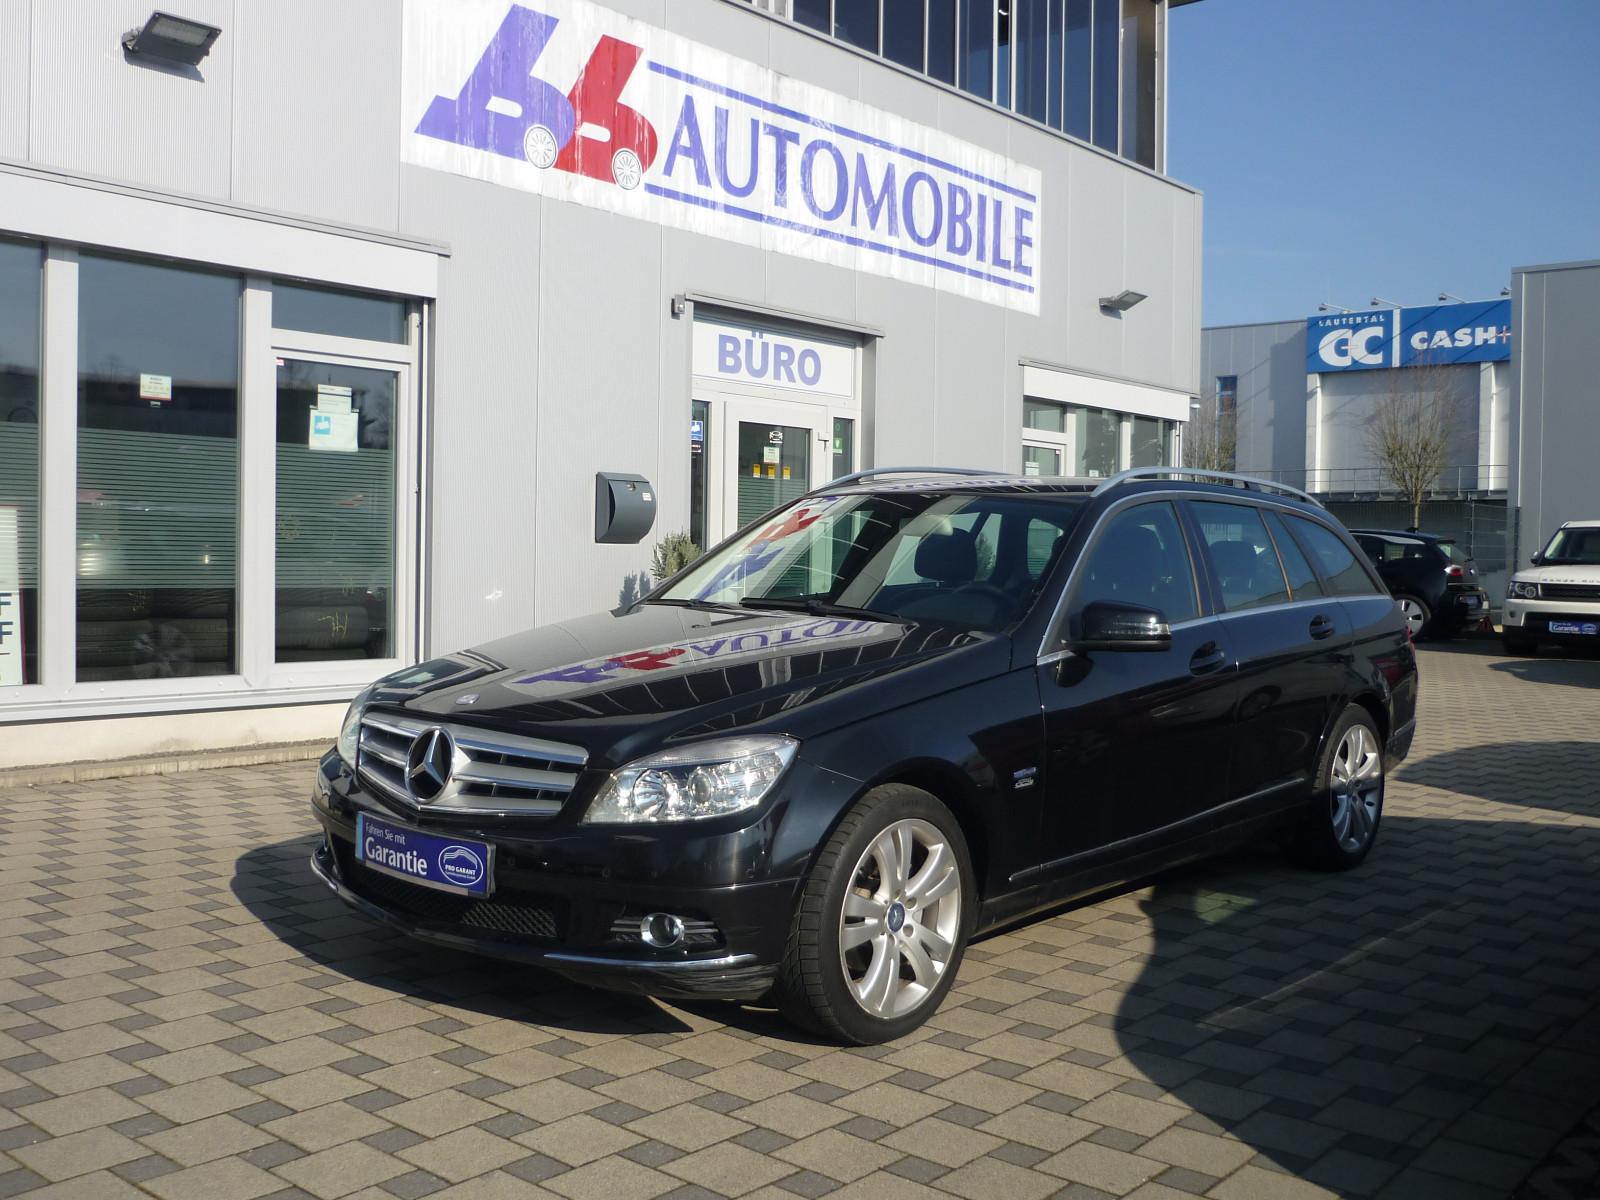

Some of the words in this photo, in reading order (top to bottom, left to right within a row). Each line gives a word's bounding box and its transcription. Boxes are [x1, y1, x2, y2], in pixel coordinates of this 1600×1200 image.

[663, 95, 1034, 277] AUTOMOBILE
[1318, 314, 1385, 327] LAUTERTAL
[718, 331, 822, 386] BÜRO
[365, 822, 384, 839] Fahren
[384, 829, 394, 841] Sie
[394, 833, 406, 846] mit
[365, 836, 428, 876] Garantie
[445, 864, 455, 872] PRO
[455, 866, 476, 876] GARANT
